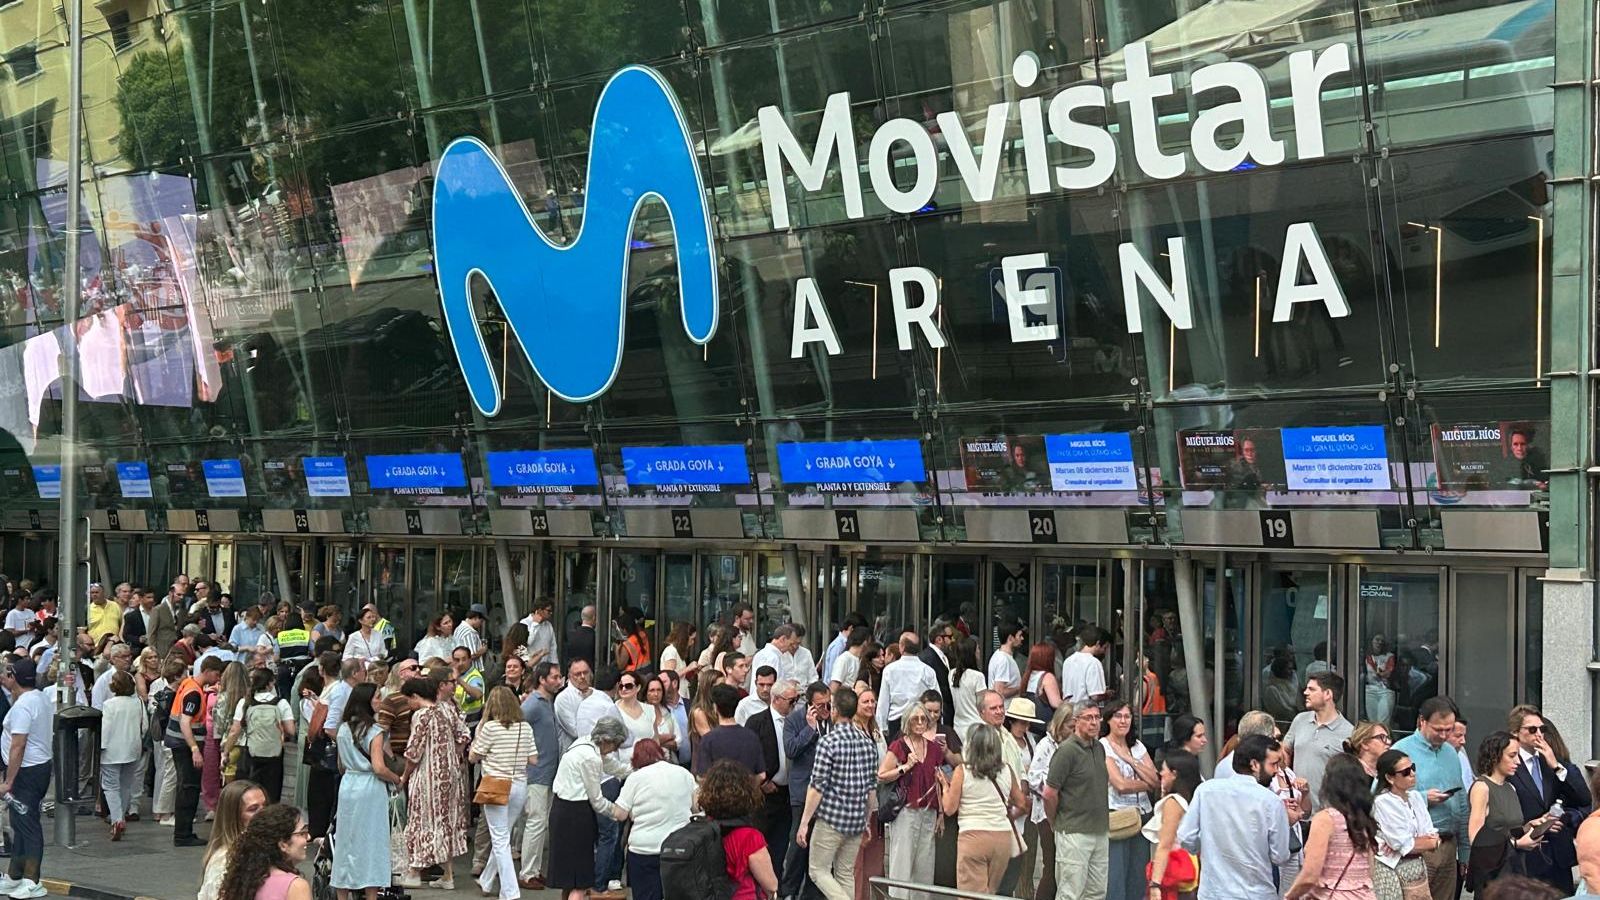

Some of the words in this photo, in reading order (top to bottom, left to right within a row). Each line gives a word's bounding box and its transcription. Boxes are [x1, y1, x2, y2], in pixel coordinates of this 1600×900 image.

[758, 41, 1350, 229] Movistar
[790, 222, 1352, 358] ARENA
[1185, 436, 1216, 446] MIGUEL
[1215, 433, 1235, 446] RÍOS
[1311, 434, 1337, 442] MIGUEL
[1338, 432, 1355, 442] RÍOS
[1441, 430, 1478, 441] MIGUEL
[1478, 427, 1501, 440] RÍOS
[515, 463, 544, 474] GRADA
[544, 462, 567, 473] GOYA
[655, 460, 686, 471] GRADA
[687, 459, 714, 471] GOYA
[816, 456, 852, 469] GRADA
[853, 455, 884, 468] GOYA
[1292, 463, 1316, 472] Martes
[1327, 463, 1362, 471] diciembre
[1363, 463, 1382, 471] 2026
[392, 466, 417, 476] GRADA
[417, 465, 438, 476] GOYA
[1084, 466, 1113, 474] diciembre
[656, 484, 679, 492] PLANTA
[688, 483, 720, 491] EXTENSIBLE
[197, 515, 207, 527] 26
[296, 515, 307, 527] 25
[407, 516, 420, 529] 24
[533, 516, 546, 530] 23
[674, 516, 690, 531] 22
[840, 516, 855, 533] 21
[1032, 518, 1053, 535] 20
[1265, 519, 1287, 538] 19
[1004, 578, 1027, 593] 08
